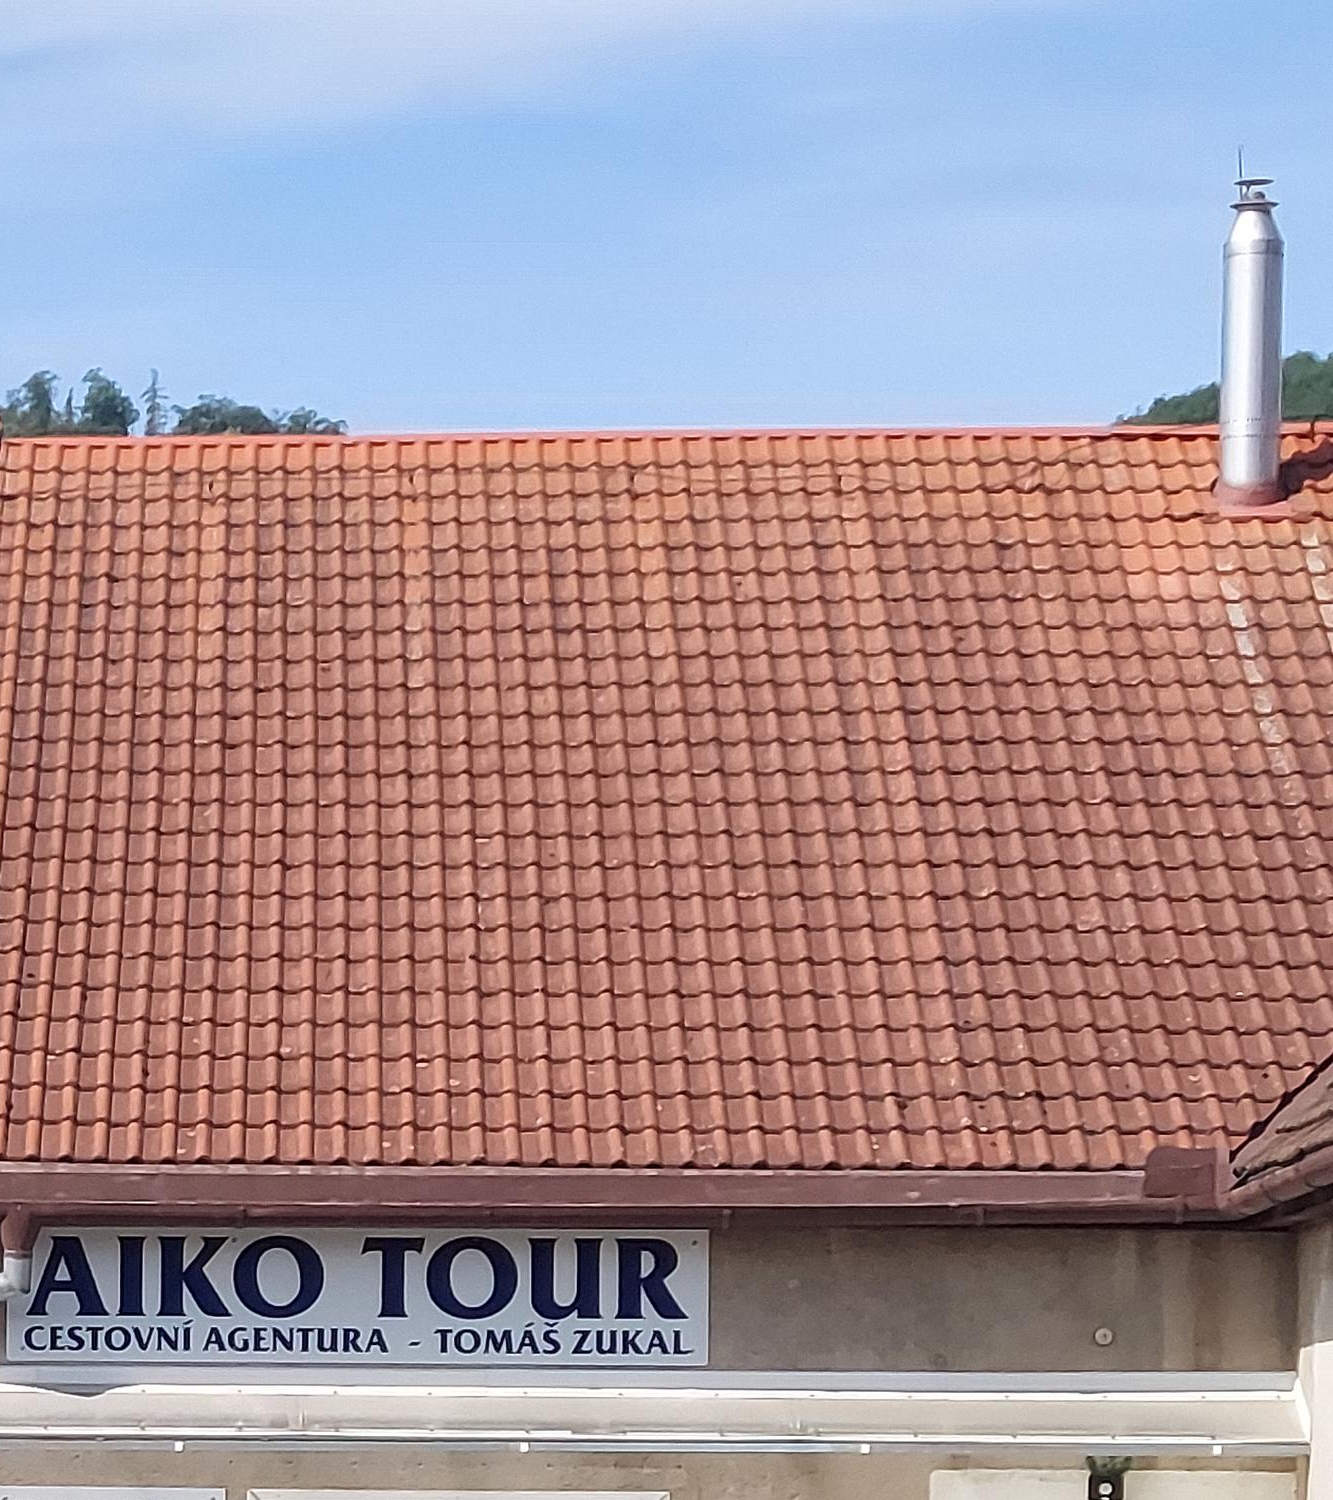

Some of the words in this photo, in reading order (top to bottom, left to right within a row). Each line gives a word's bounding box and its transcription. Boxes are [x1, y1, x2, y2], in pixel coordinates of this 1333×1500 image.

[26, 1235, 325, 1318] AIKO
[361, 1236, 689, 1320] TOUR
[24, 1319, 194, 1352] CESTOVNÍ
[203, 1326, 389, 1353] AGENTURA
[434, 1322, 561, 1355] TOMÁŠ
[571, 1329, 694, 1355] ZUKAL
